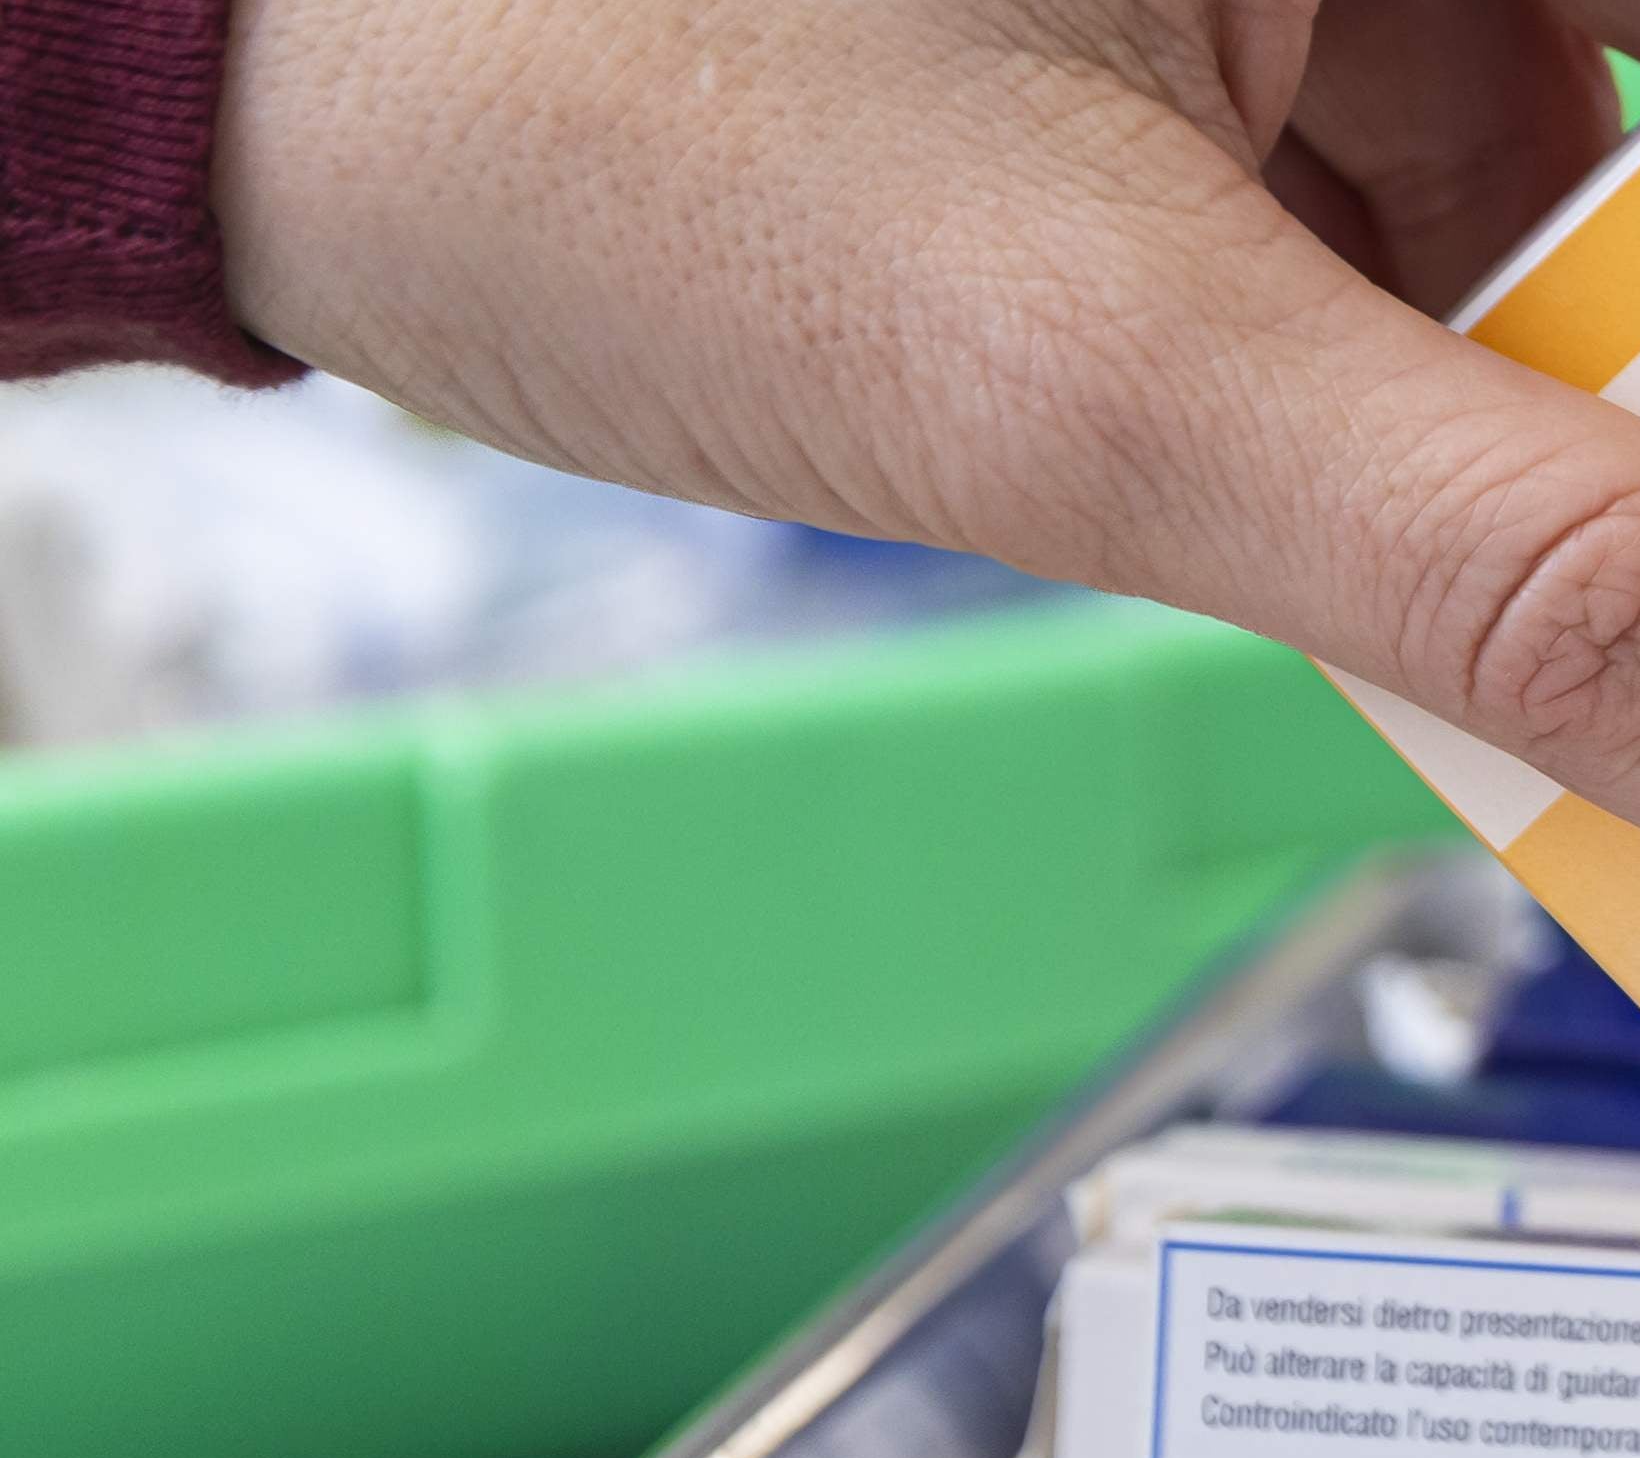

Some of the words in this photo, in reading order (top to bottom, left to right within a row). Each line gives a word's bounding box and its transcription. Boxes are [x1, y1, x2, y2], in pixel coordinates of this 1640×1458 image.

[1207, 1287, 1241, 1320] Da
[1251, 1295, 1363, 1328] vendersi
[1373, 1298, 1450, 1333] dietro
[1204, 1341, 1255, 1375] Può
[1264, 1348, 1365, 1381] alterare
[1374, 1353, 1396, 1383] la
[1405, 1357, 1514, 1394] capacità
[1524, 1362, 1548, 1393] di
[1201, 1395, 1398, 1438] Controindicato
[1407, 1407, 1470, 1443] l'uso
